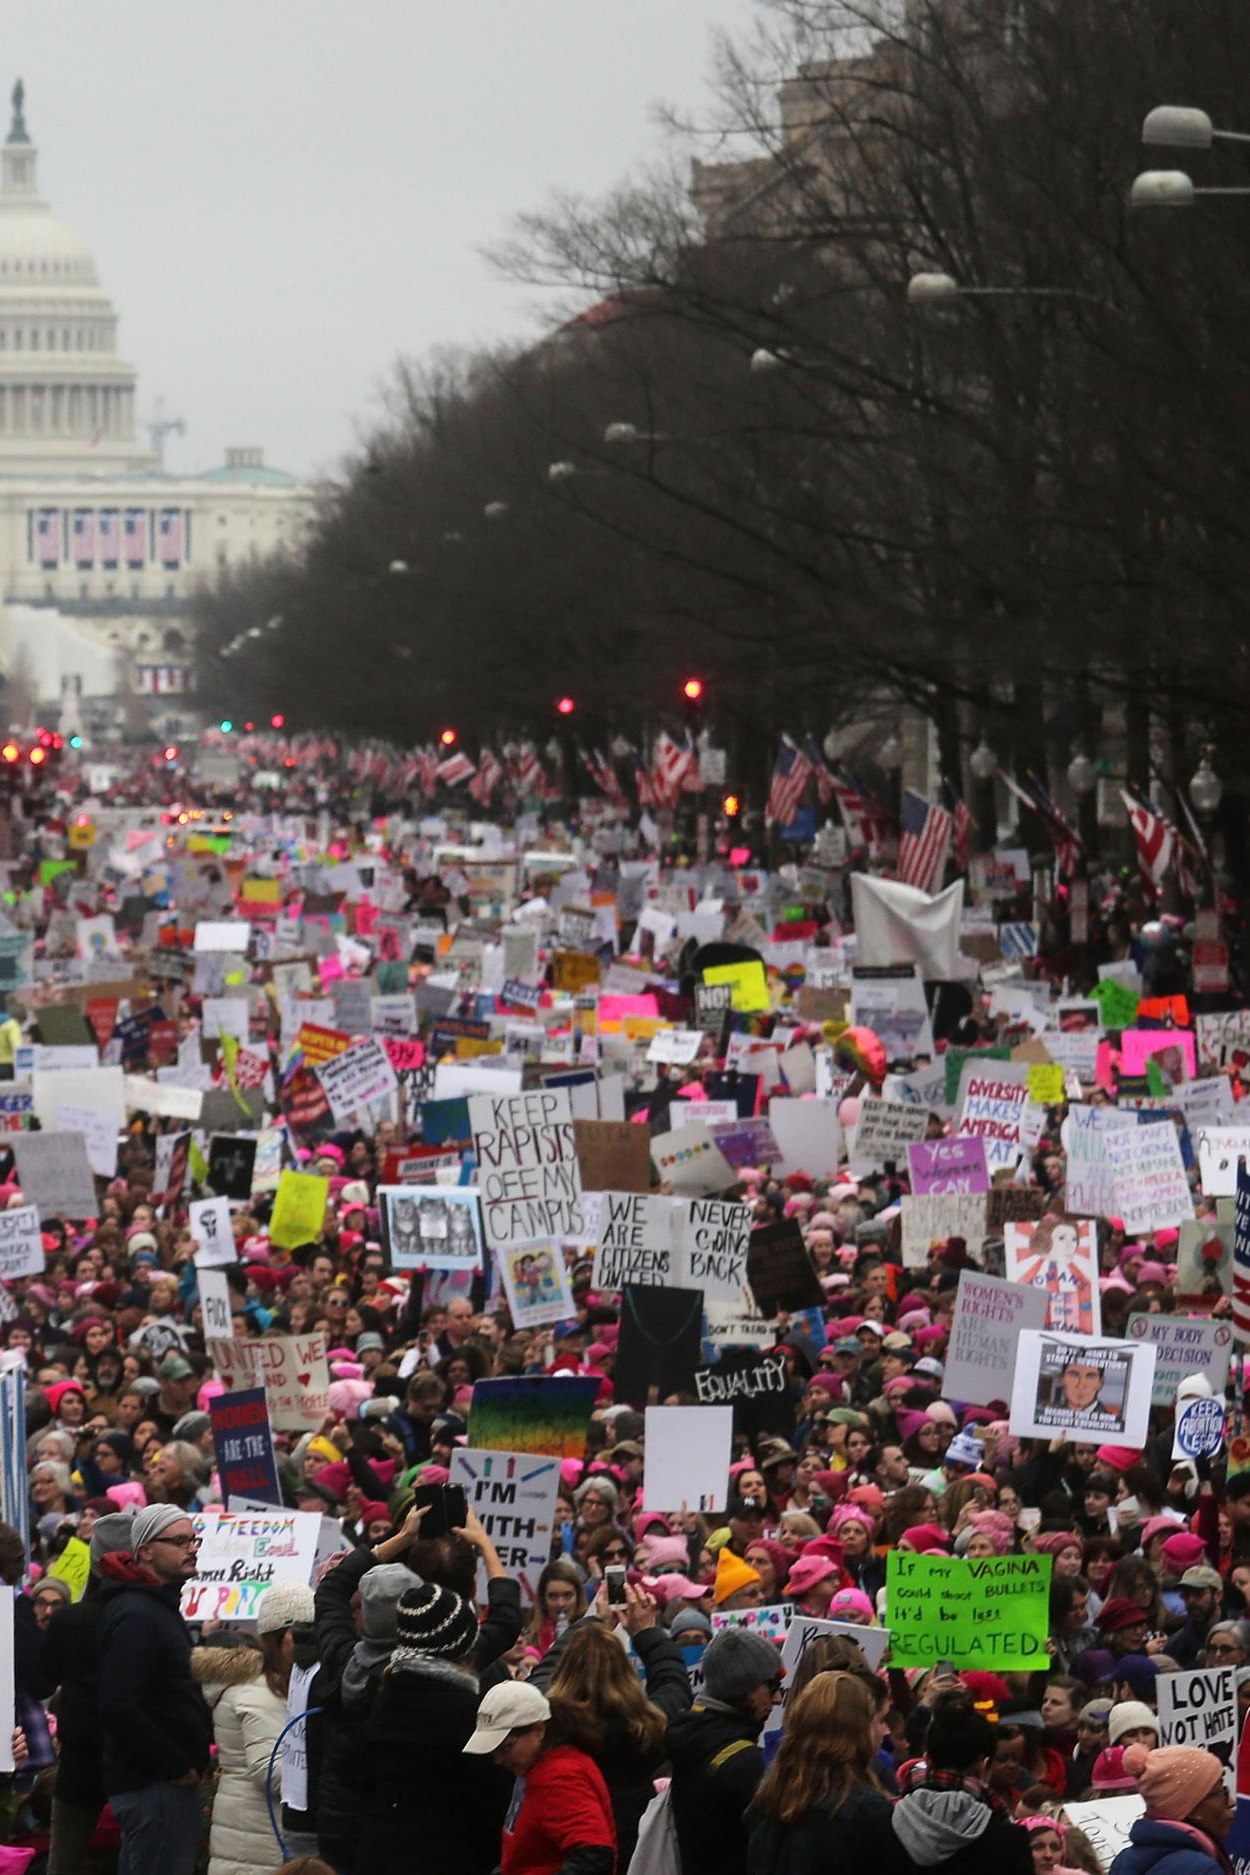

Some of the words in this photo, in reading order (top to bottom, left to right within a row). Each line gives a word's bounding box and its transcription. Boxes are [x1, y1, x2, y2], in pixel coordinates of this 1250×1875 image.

[699, 987, 730, 1008] NO!
[968, 1078, 1029, 1103] DIVERSITY
[491, 1095, 558, 1130] KEEP
[967, 1099, 1022, 1121] MAKES
[960, 1117, 1021, 1143] AMERICA
[475, 1123, 576, 1167] RAPISTS
[486, 1168, 538, 1200] OFF
[543, 1162, 577, 1200] MY
[915, 1162, 982, 1180] Women
[488, 1200, 585, 1241] CAMPUS
[608, 1194, 649, 1224] WE
[690, 1201, 752, 1231] NEVER
[602, 1224, 644, 1247] ARE
[695, 1229, 750, 1258] GOING
[601, 1248, 670, 1273] CITIZENS
[690, 1253, 743, 1287] BACK
[598, 1269, 665, 1287] UNITED
[964, 1281, 1024, 1308] WOMEN'S
[206, 1297, 227, 1328] FUCK
[958, 1316, 988, 1331] ARE
[961, 1300, 1014, 1323] RIGHTS
[709, 1324, 735, 1335] DON'T
[957, 1330, 1010, 1351] HUMAN
[1151, 1326, 1168, 1341] MY
[1174, 1328, 1204, 1344] BODY
[210, 1343, 285, 1370] UNITED
[296, 1340, 325, 1365] WE
[954, 1347, 1007, 1369] RIGHTS
[1156, 1349, 1212, 1365] DECISION
[694, 1354, 787, 1402] EQUALITY
[213, 1403, 267, 1430] WOMEN
[1044, 1407, 1073, 1418] BECAUSE
[1192, 1401, 1217, 1415] KEEP
[1052, 1416, 1074, 1427] START
[1181, 1417, 1222, 1435] ABORTION
[224, 1440, 242, 1462] ARE
[244, 1436, 265, 1458] THE
[226, 1466, 270, 1492] WALL
[475, 1481, 517, 1505] I'M
[497, 1546, 528, 1568] ER
[967, 1560, 1040, 1579] VAGINA
[985, 1580, 1045, 1598] BULLETS
[895, 1606, 922, 1621] it'd
[939, 1606, 958, 1621] be
[973, 1608, 1000, 1621] less
[888, 1632, 1039, 1656] REGULATED
[1171, 1671, 1234, 1710] LOVE
[1161, 1715, 1198, 1746] NOT
[1203, 1706, 1235, 1739] HATE
